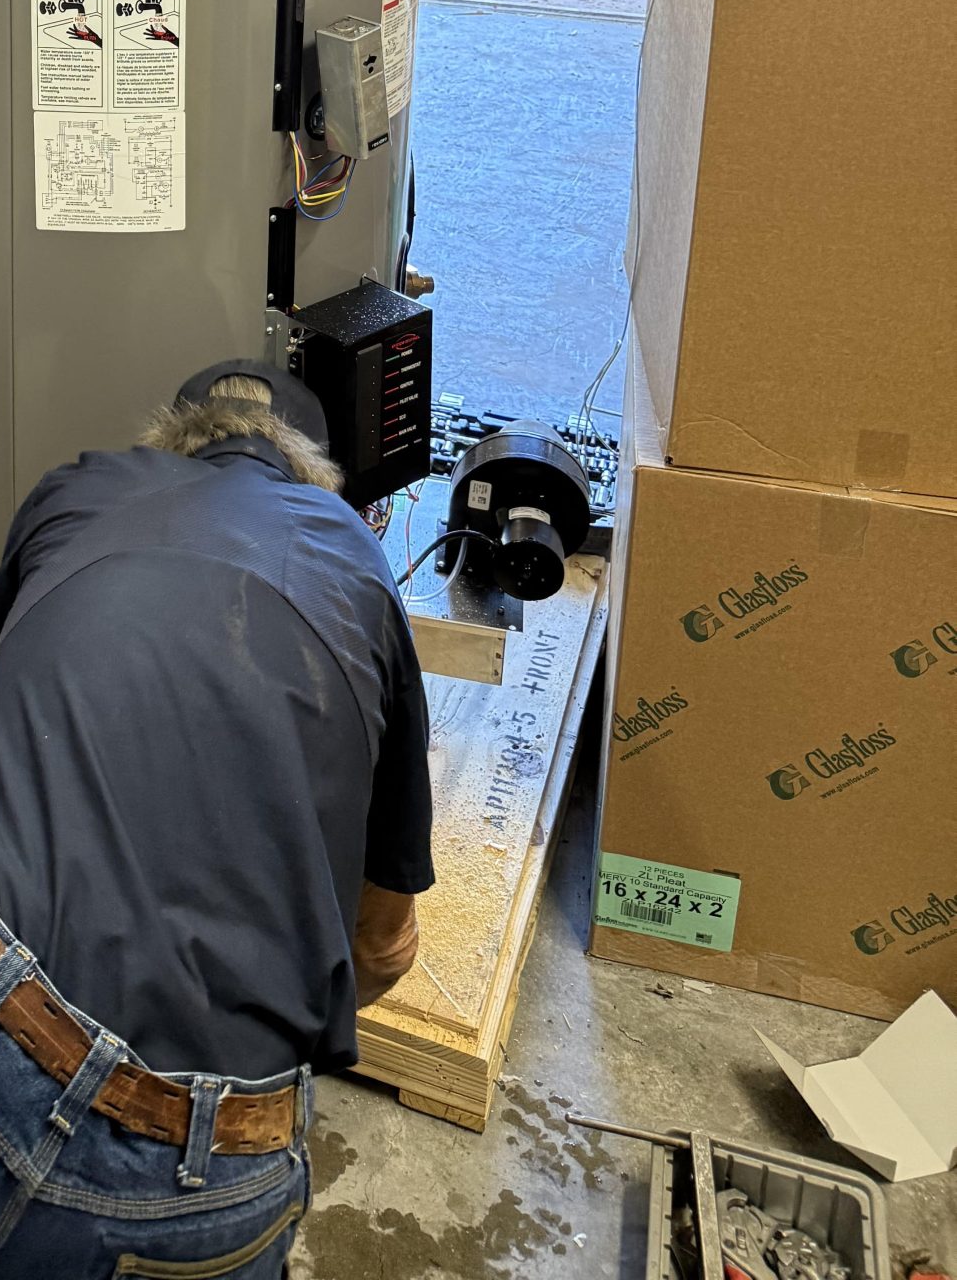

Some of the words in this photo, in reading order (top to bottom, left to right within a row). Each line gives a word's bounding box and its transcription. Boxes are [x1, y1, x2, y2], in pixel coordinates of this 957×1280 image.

[401, 348, 413, 357] POWER
[718, 564, 808, 619] Glasfloss
[734, 604, 792, 640] www.glasfloss.com
[521, 629, 560, 695] FRONT
[612, 691, 689, 742] Glasfloss
[619, 728, 674, 762] www.glasfloss.com
[804, 728, 896, 779] Glasfloss
[820, 766, 880, 800] www.glasfloss.com
[598, 871, 627, 882] MERV
[629, 878, 641, 886] 10
[642, 880, 684, 895] Standard
[686, 889, 727, 904] Capacity
[638, 871, 653, 881] ZL
[656, 874, 687, 888] Pleat
[654, 867, 685, 879] PIECES
[602, 880, 627, 898] 16
[634, 889, 647, 901] x
[654, 890, 682, 908] 24
[688, 900, 702, 914] x
[709, 902, 723, 918] 2
[890, 892, 957, 936] Glasflo
